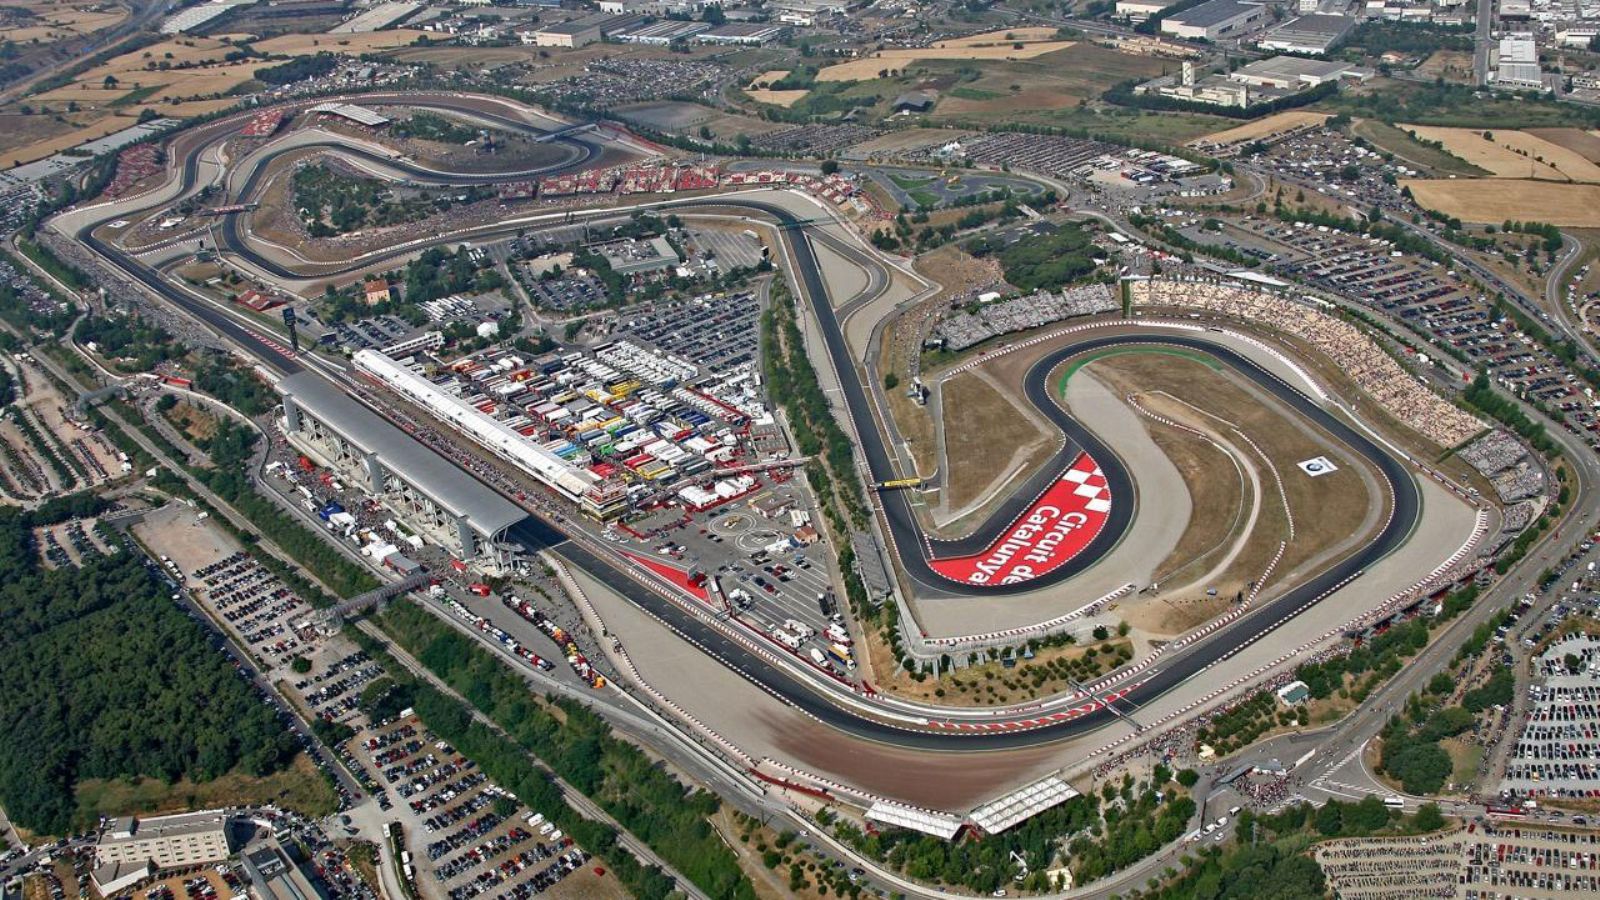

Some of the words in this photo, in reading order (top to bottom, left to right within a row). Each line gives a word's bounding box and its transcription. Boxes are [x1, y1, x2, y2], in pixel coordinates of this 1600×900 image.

[968, 505, 1061, 584] Catalunya
[1024, 512, 1087, 563] Circuit
[1001, 565, 1036, 586] de
